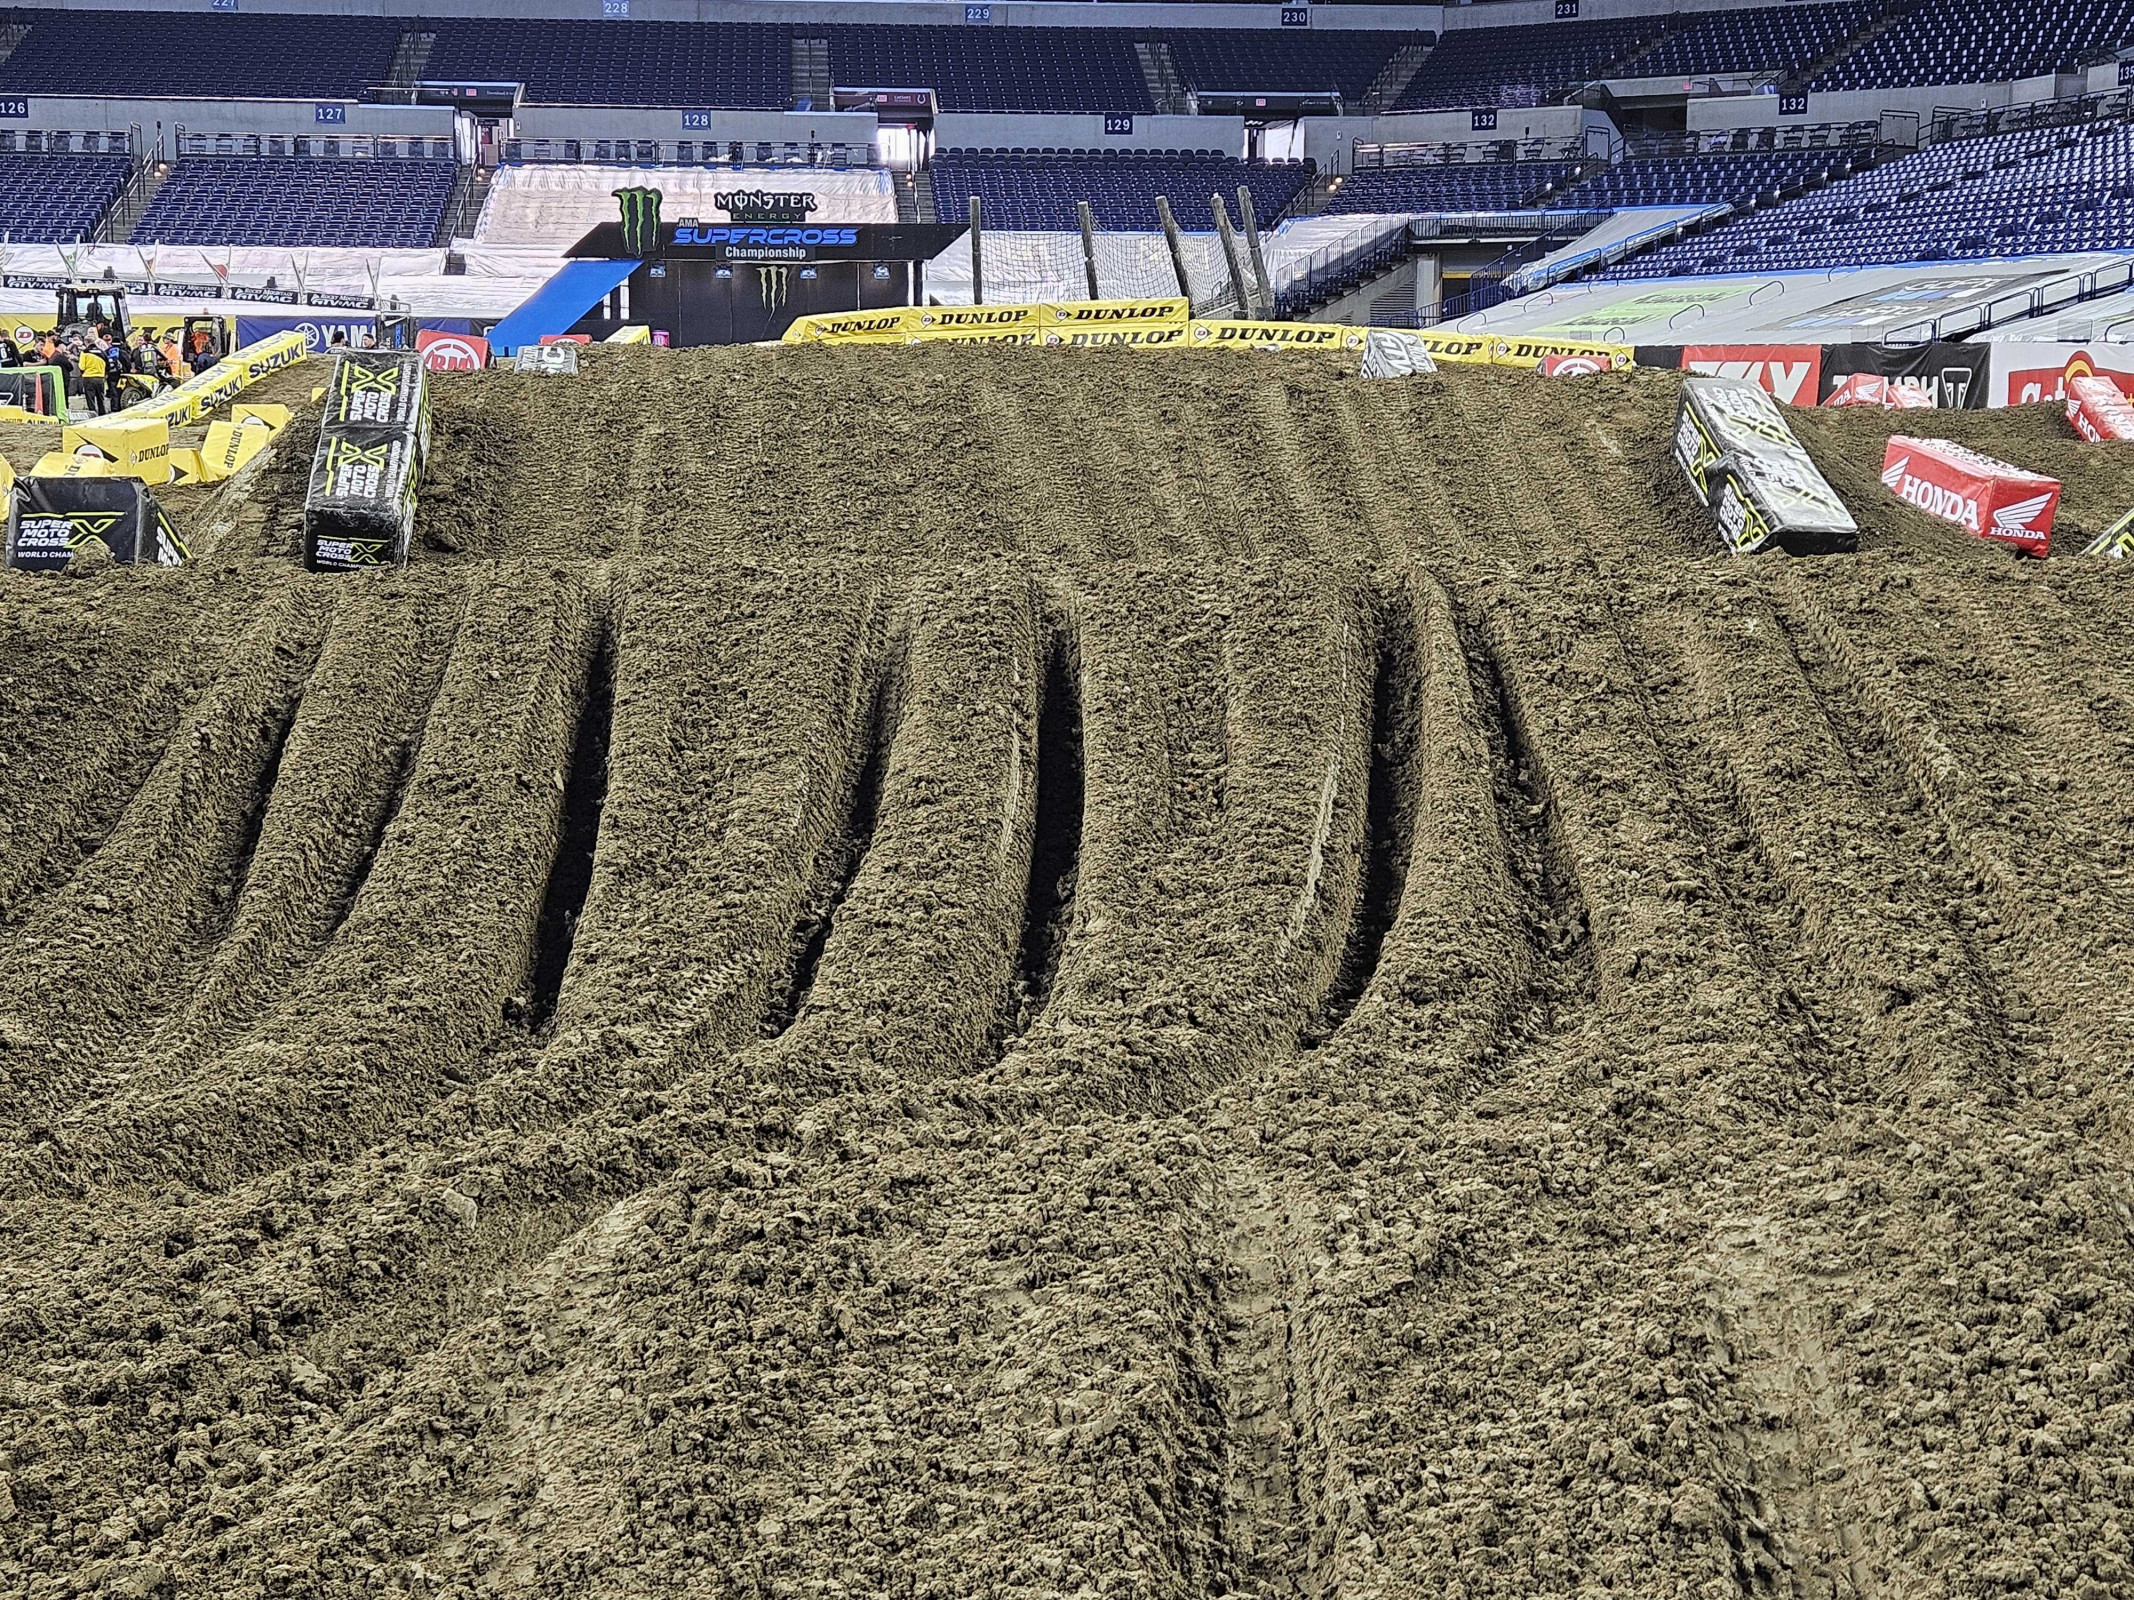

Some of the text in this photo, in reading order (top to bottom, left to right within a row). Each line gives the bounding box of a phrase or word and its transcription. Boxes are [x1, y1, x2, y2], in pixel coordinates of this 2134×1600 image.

[605, 2, 628, 14] 228
[967, 8, 990, 19] 229
[1557, 3, 1577, 15] 231
[1283, 11, 1306, 23] 230
[0, 102, 26, 114] 126
[1782, 97, 1805, 111] 132
[318, 108, 342, 120] 127
[684, 114, 709, 126] 128
[1474, 114, 1495, 127] 132
[1107, 119, 1131, 131] 129
[717, 191, 817, 211] MONSTER
[678, 218, 699, 228] AMA
[732, 212, 802, 220] ENERGY
[673, 228, 858, 245] SUPERCROSS
[725, 246, 807, 259] Championship
[939, 309, 1029, 325] DUNLOP
[1074, 305, 1175, 320] DUNLOP
[829, 316, 901, 333] DUNLOP
[1070, 329, 1184, 346] DUNLOP
[1216, 327, 1336, 344] DUNLOP
[248, 341, 304, 379] SUZUKI
[201, 374, 243, 412] SUZUKI
[350, 390, 367, 421] SUPER
[363, 391, 379, 420] MOTO
[376, 391, 393, 423] CROSS
[1680, 422, 1698, 457] MOTO
[224, 430, 243, 469] DUNLOP
[336, 463, 354, 498] SUPER
[350, 465, 367, 497] MOTO
[364, 464, 380, 499] CROSS
[1724, 483, 1746, 521] SUPER
[1900, 474, 1980, 530] HONDA
[1722, 496, 1744, 531] MOTO
[20, 519, 73, 530] SUPER
[1720, 505, 1740, 542] CROSS
[22, 529, 70, 538] MOTO
[1989, 526, 2047, 540] HONDA
[17, 537, 70, 547] CROSS
[316, 540, 355, 550] SUPER
[315, 551, 353, 562] CROSS
[319, 546, 353, 555] MOTO
[316, 559, 338, 567] WORLD
